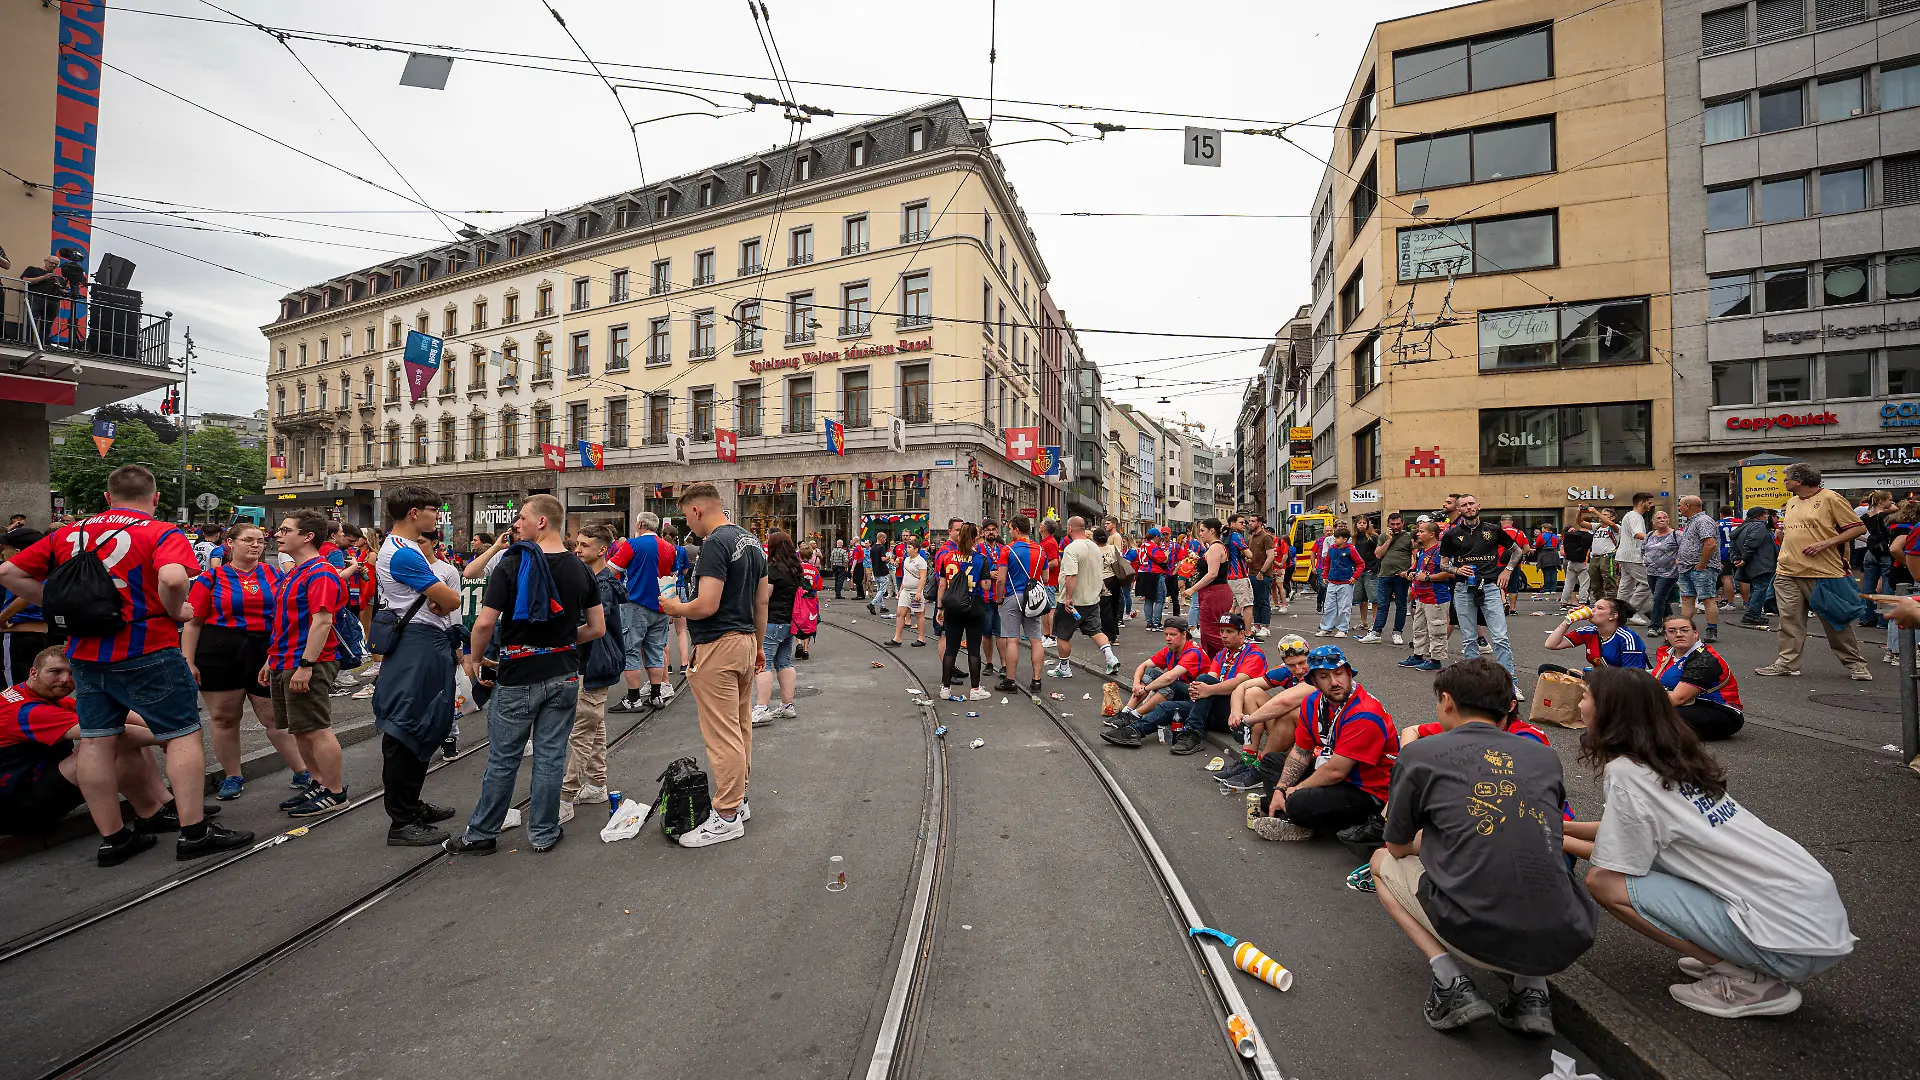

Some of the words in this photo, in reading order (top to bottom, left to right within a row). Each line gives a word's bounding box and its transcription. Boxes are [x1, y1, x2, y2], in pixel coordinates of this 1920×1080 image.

[1191, 134, 1215, 159] 15
[1402, 234, 1411, 278] MADIBA
[749, 357, 800, 374] Spielzeug
[801, 349, 840, 366] Welten
[1726, 411, 1839, 431] CopyQuick
[1497, 431, 1542, 447] Salt.
[1877, 447, 1907, 460] CTR
[1353, 490, 1376, 499] Salt.
[1567, 485, 1615, 501] Salt.
[474, 509, 518, 525] APOTHEKE
[460, 586, 484, 616] 11
